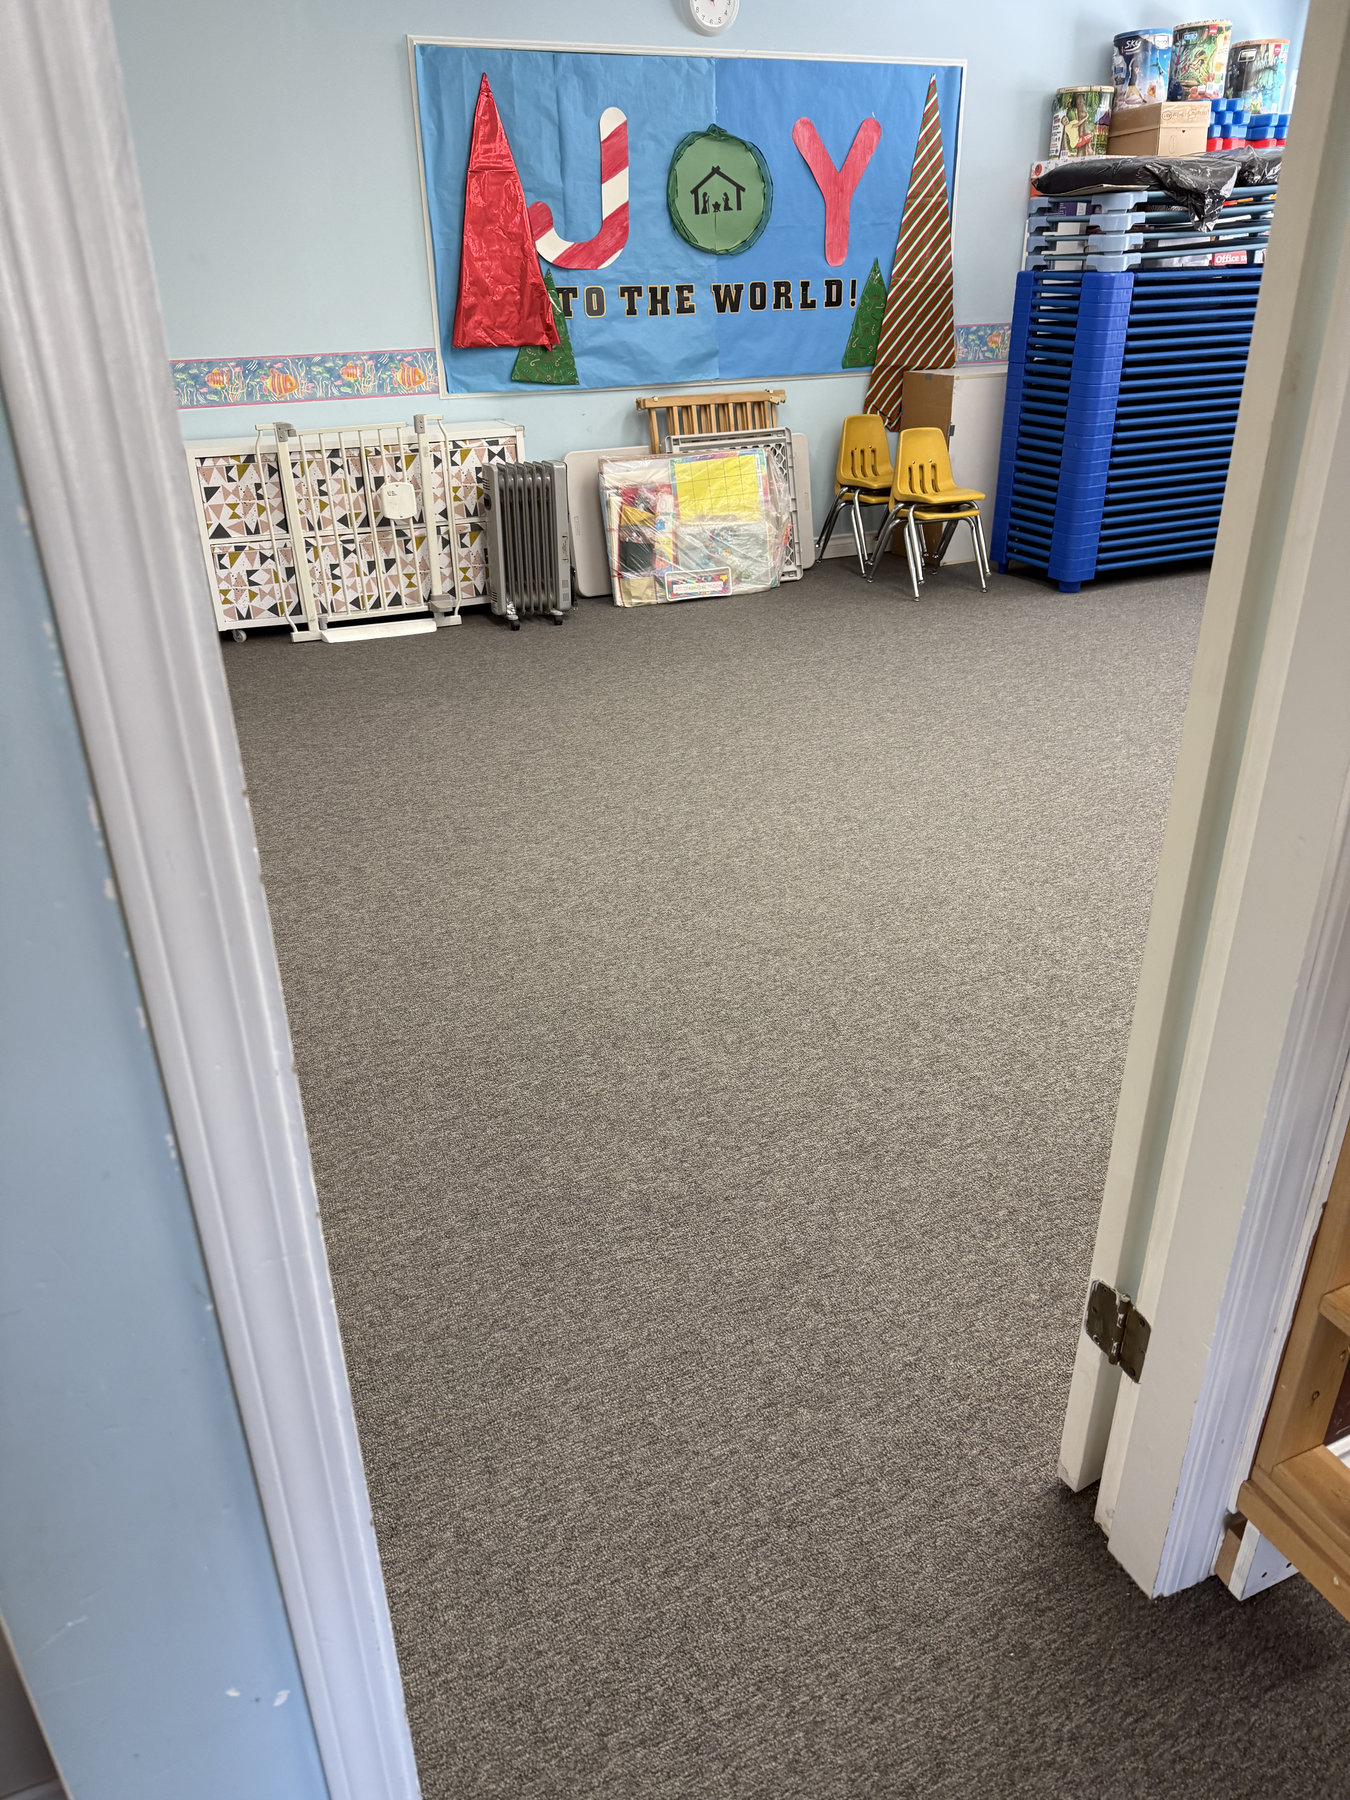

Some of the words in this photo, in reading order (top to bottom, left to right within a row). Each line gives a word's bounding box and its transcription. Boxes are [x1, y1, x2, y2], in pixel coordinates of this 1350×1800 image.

[527, 106, 882, 270] JOY
[1215, 254, 1240, 264] Office
[555, 285, 606, 319] TO
[618, 283, 697, 317] THE
[711, 278, 857, 315] WORLD!
